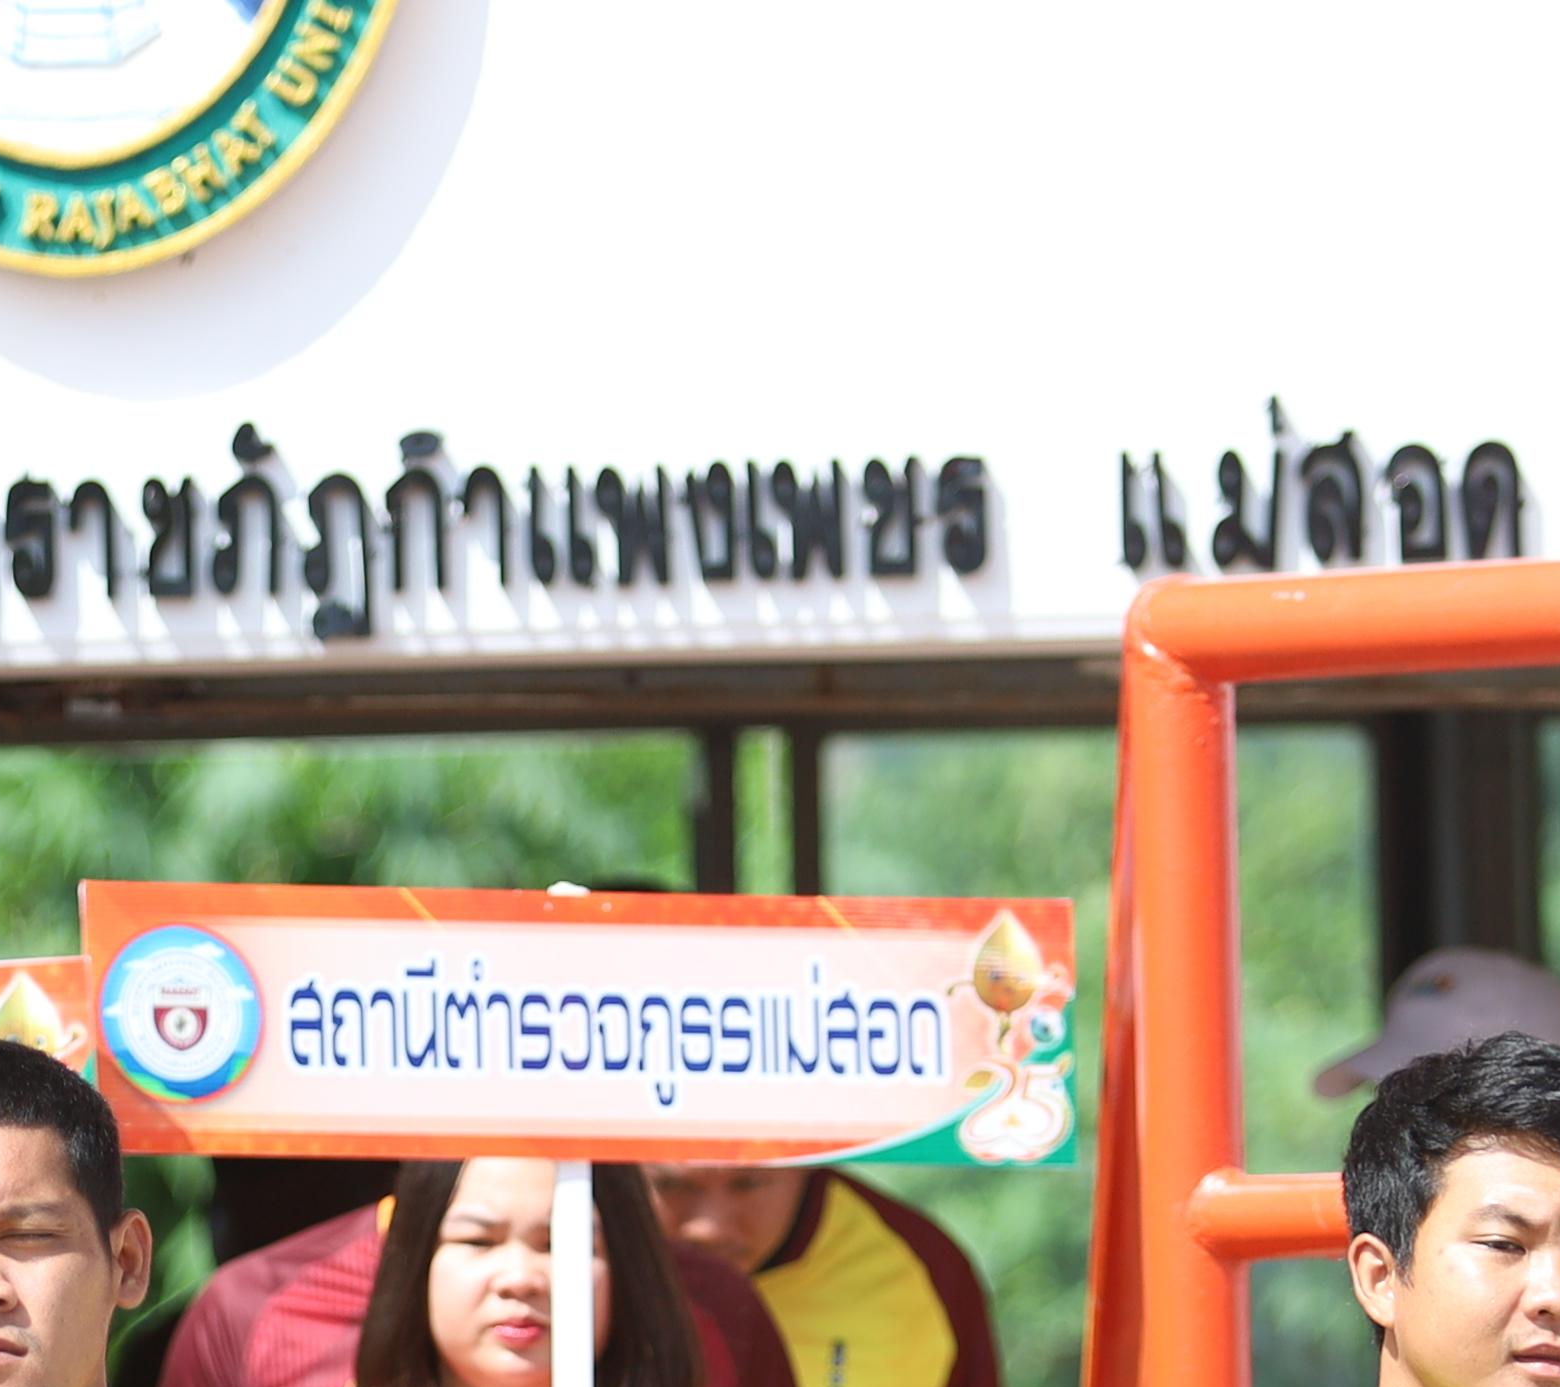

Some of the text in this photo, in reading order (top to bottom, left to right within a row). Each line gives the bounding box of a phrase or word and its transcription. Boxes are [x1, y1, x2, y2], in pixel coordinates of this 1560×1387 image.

[18, 97, 276, 250] RAJABHAT
[1120, 397, 1525, 570] แม่สอด
[290, 957, 943, 1106] สถานีตำรวจภูธรแม่สอด
